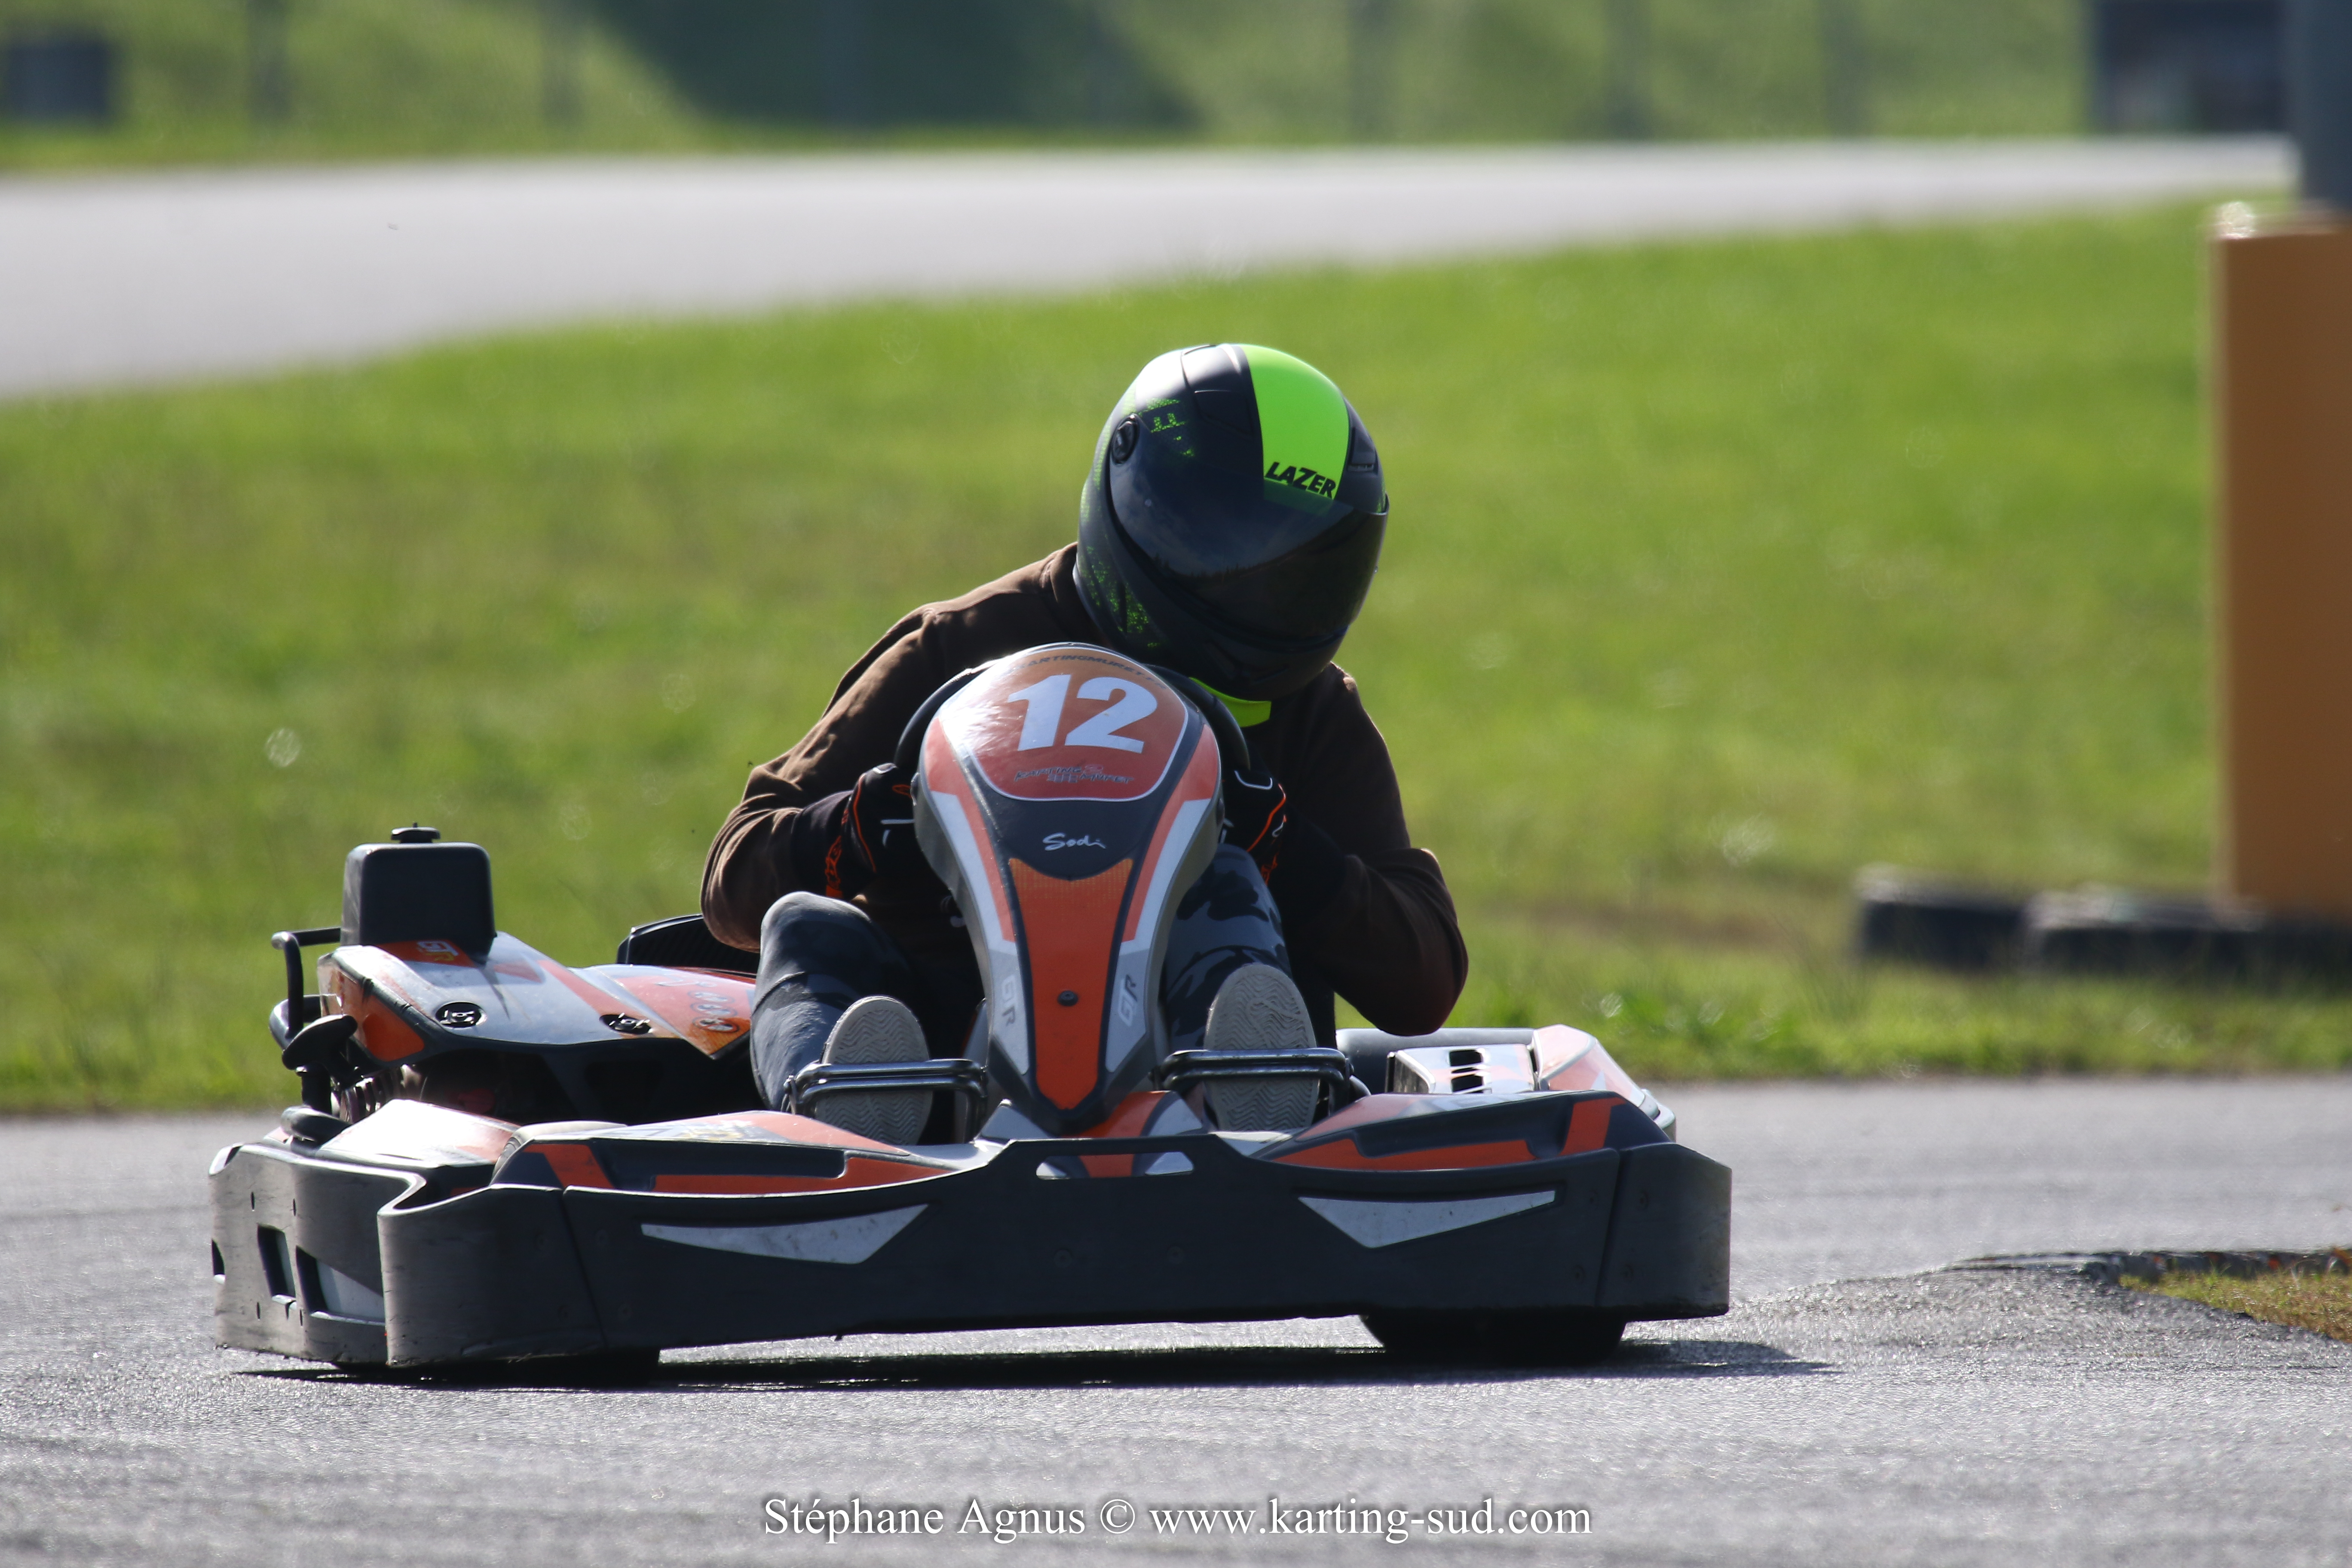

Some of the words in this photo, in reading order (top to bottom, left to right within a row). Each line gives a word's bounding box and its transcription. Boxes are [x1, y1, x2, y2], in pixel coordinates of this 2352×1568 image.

[1265, 461, 1336, 499] LAZER
[1008, 674, 1158, 754] 12
[1042, 832, 1106, 851] Sodi
